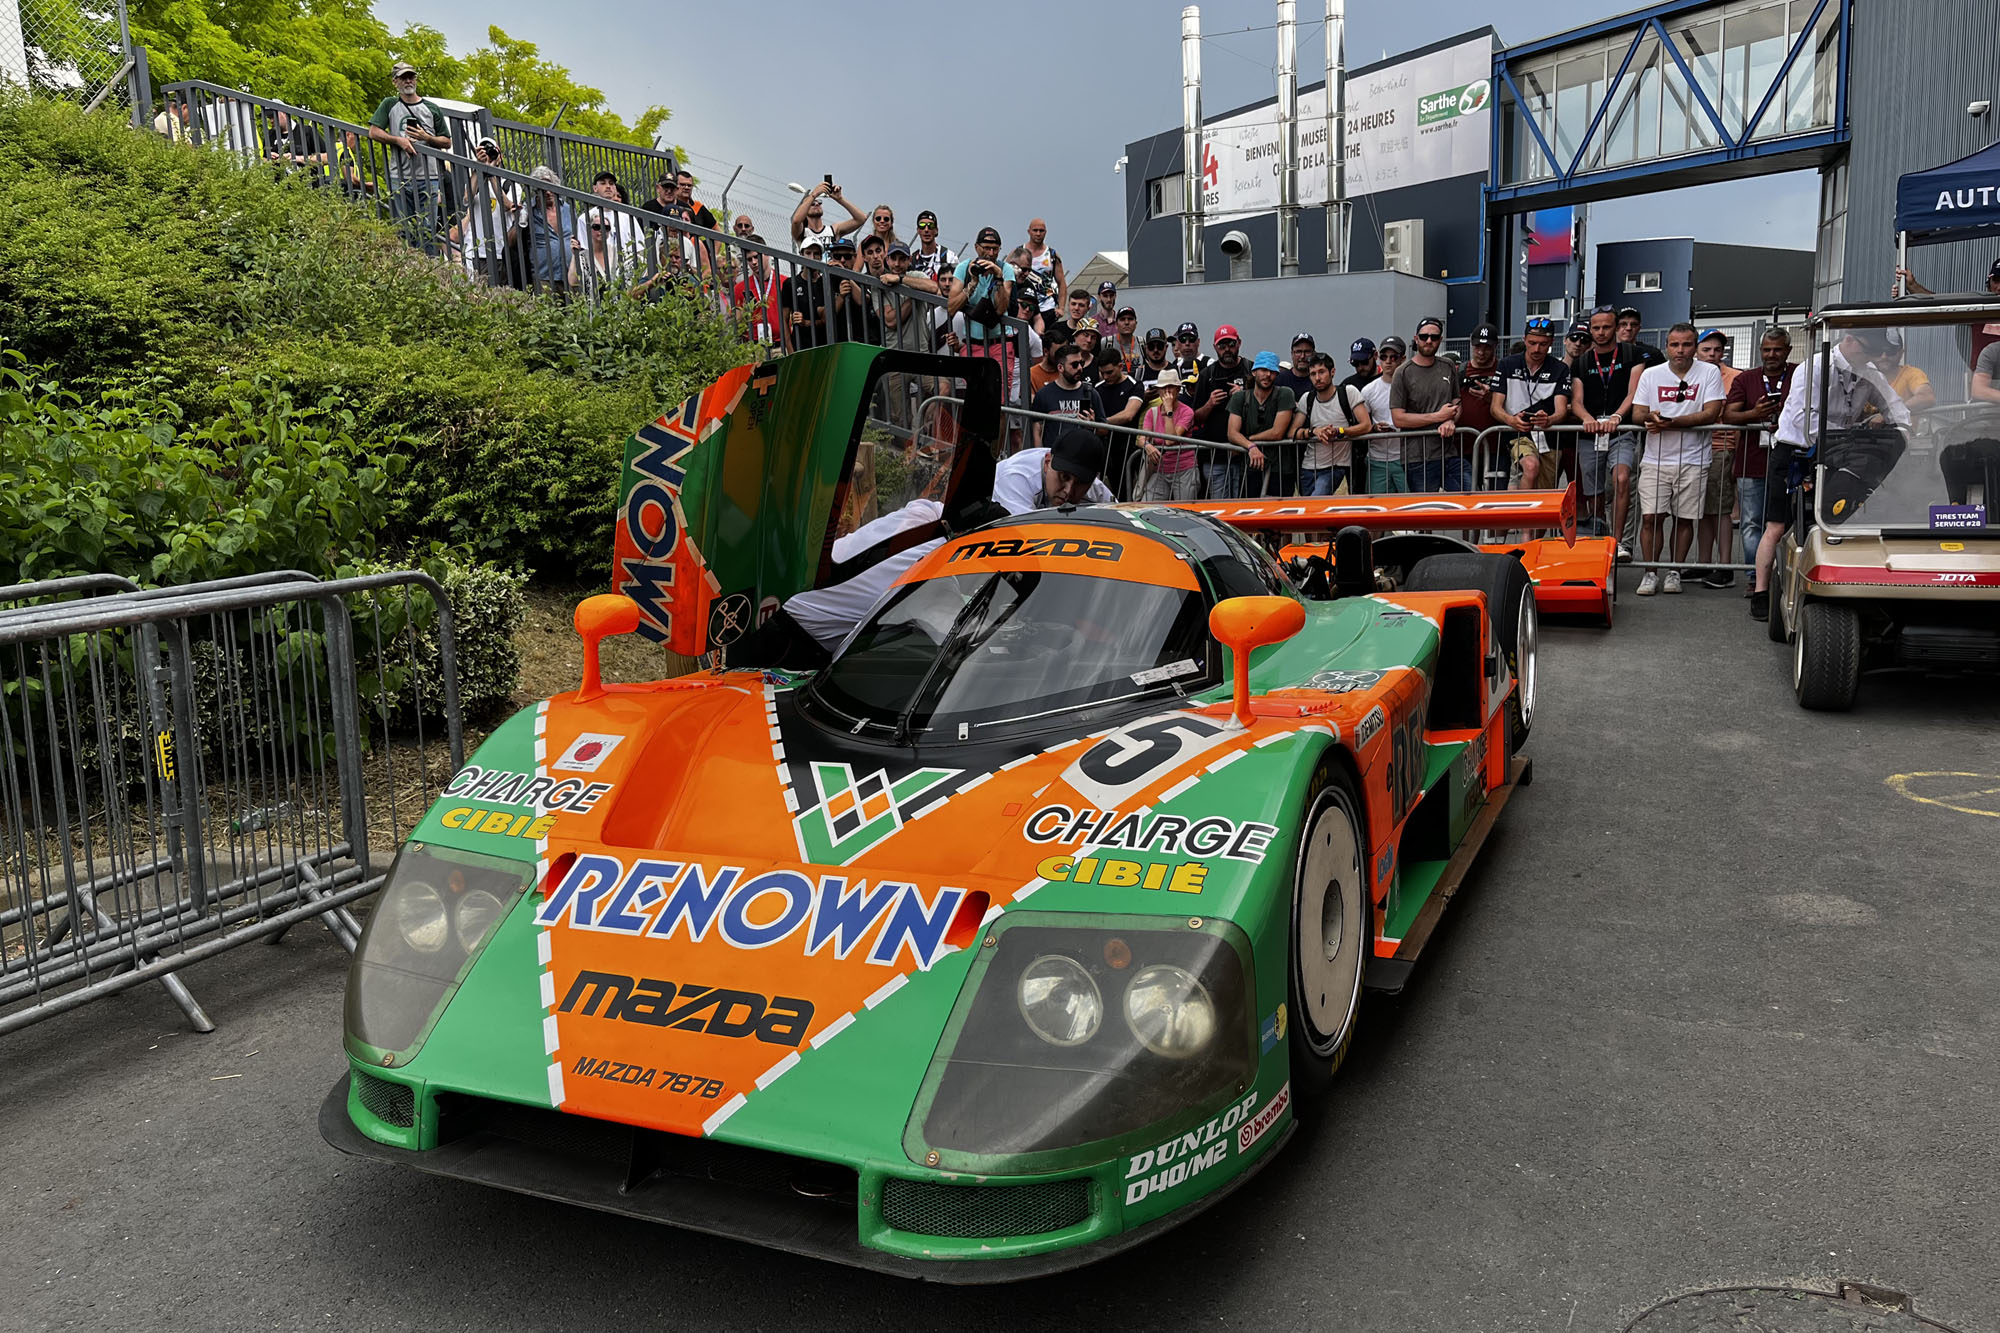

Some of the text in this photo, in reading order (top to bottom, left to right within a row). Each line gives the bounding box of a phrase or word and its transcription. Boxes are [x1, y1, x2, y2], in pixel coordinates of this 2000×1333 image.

[1420, 93, 1457, 115] Sarthe
[1301, 126, 1327, 148] MUSÉE
[1347, 119, 1359, 136] 24
[1360, 109, 1395, 133] HEURES
[1420, 119, 1458, 135] www.sarthe.fr
[1303, 156, 1313, 170] DE
[1314, 152, 1325, 167] LA
[1345, 142, 1361, 160] THE
[1935, 186, 2000, 211] AUT
[948, 538, 1126, 563] mazda
[1931, 573, 1976, 582] JOTA
[1079, 716, 1225, 786] 5
[440, 764, 615, 815] CHARGE
[441, 806, 558, 840] CIBIÉ
[1023, 803, 1280, 865] CHARGE
[1036, 855, 1210, 895] CIBIÉ
[533, 853, 967, 972] RENOWN
[558, 969, 816, 1048] mazda
[571, 1056, 725, 1099] MAZDA 787B
[1254, 1089, 1289, 1137] brembo
[1125, 1091, 1258, 1180] DUNLOP
[1125, 1138, 1228, 1206] D40/M2
